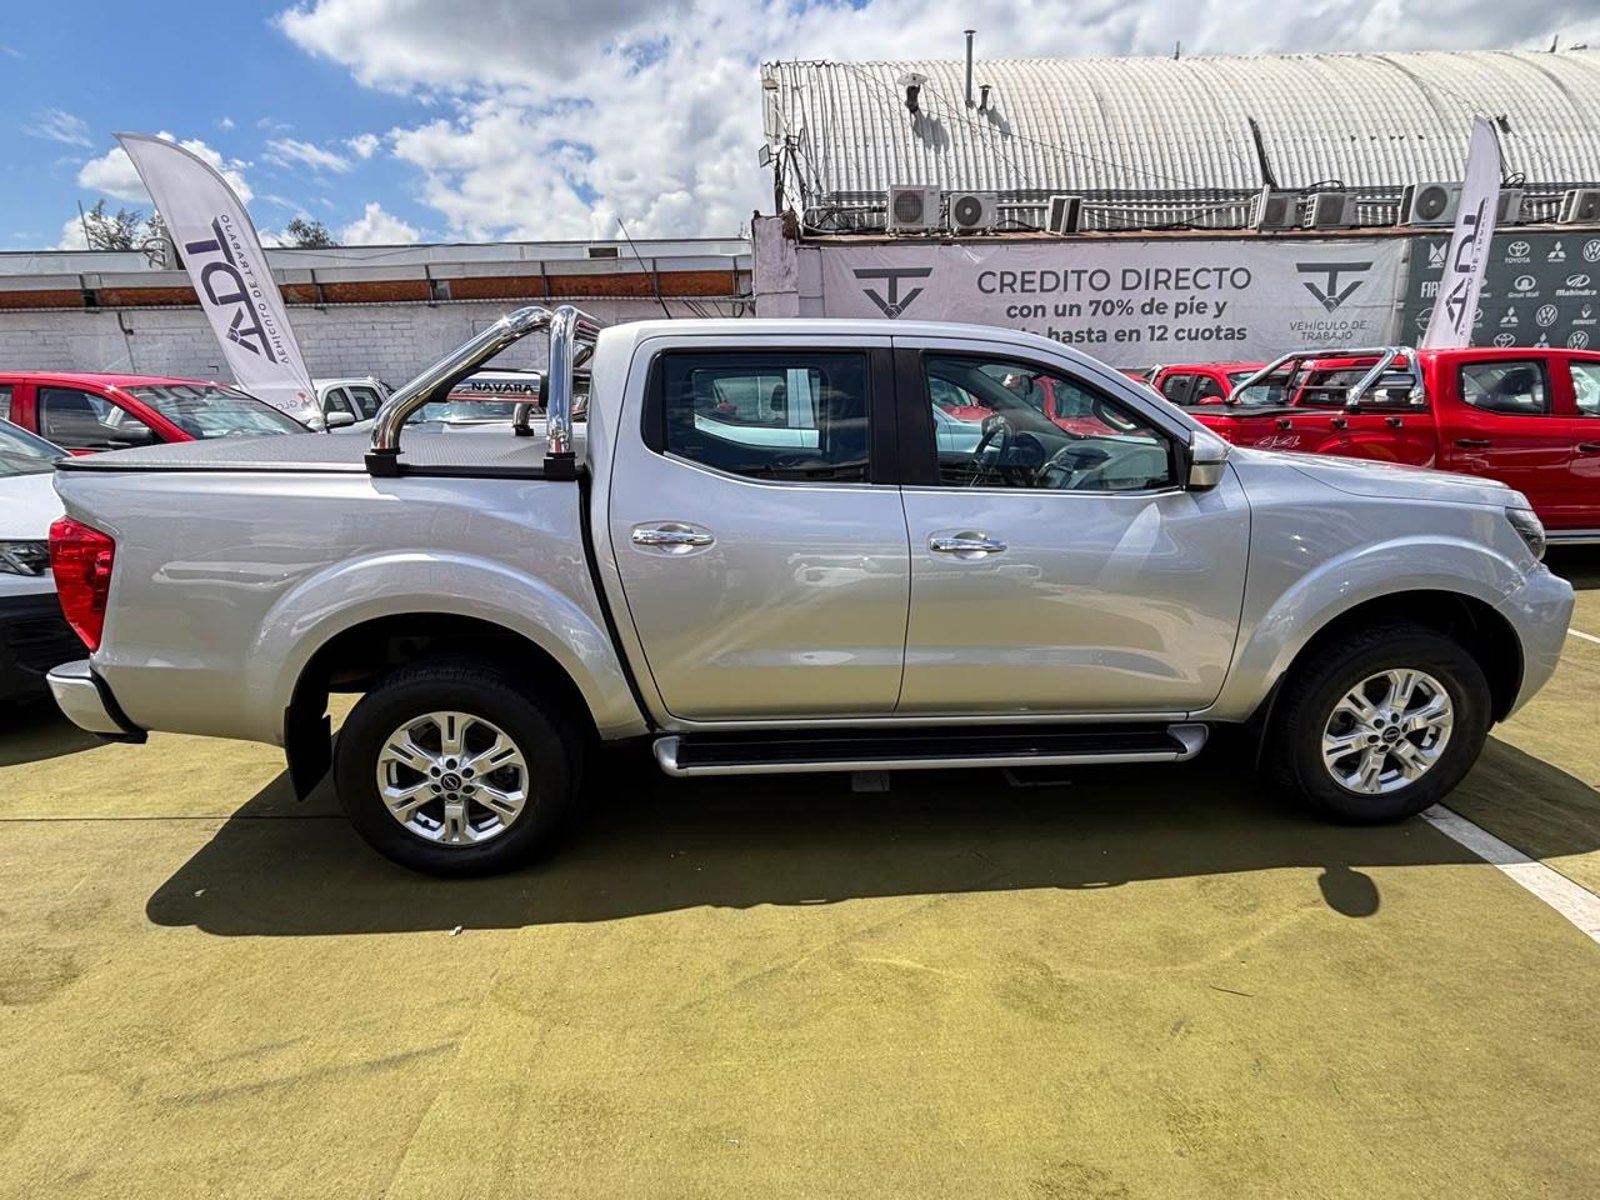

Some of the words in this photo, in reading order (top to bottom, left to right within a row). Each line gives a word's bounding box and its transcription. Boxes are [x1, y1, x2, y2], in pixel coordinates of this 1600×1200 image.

[977, 270, 1111, 294] CREDITO
[1121, 267, 1252, 292] DIRECTO
[1420, 281, 1441, 298] FIA
[1006, 304, 1046, 319] con
[1054, 302, 1082, 318] un
[1089, 299, 1135, 318] 70%
[1140, 297, 1169, 316] de
[1214, 300, 1229, 319] y
[1351, 320, 1368, 330] DE
[1047, 326, 1108, 344] hasta
[1114, 329, 1142, 343] en
[1148, 325, 1169, 343] 12
[1174, 325, 1248, 342] cuotas
[1301, 331, 1354, 341] TRABAJO
[471, 382, 534, 392] NAVARA
